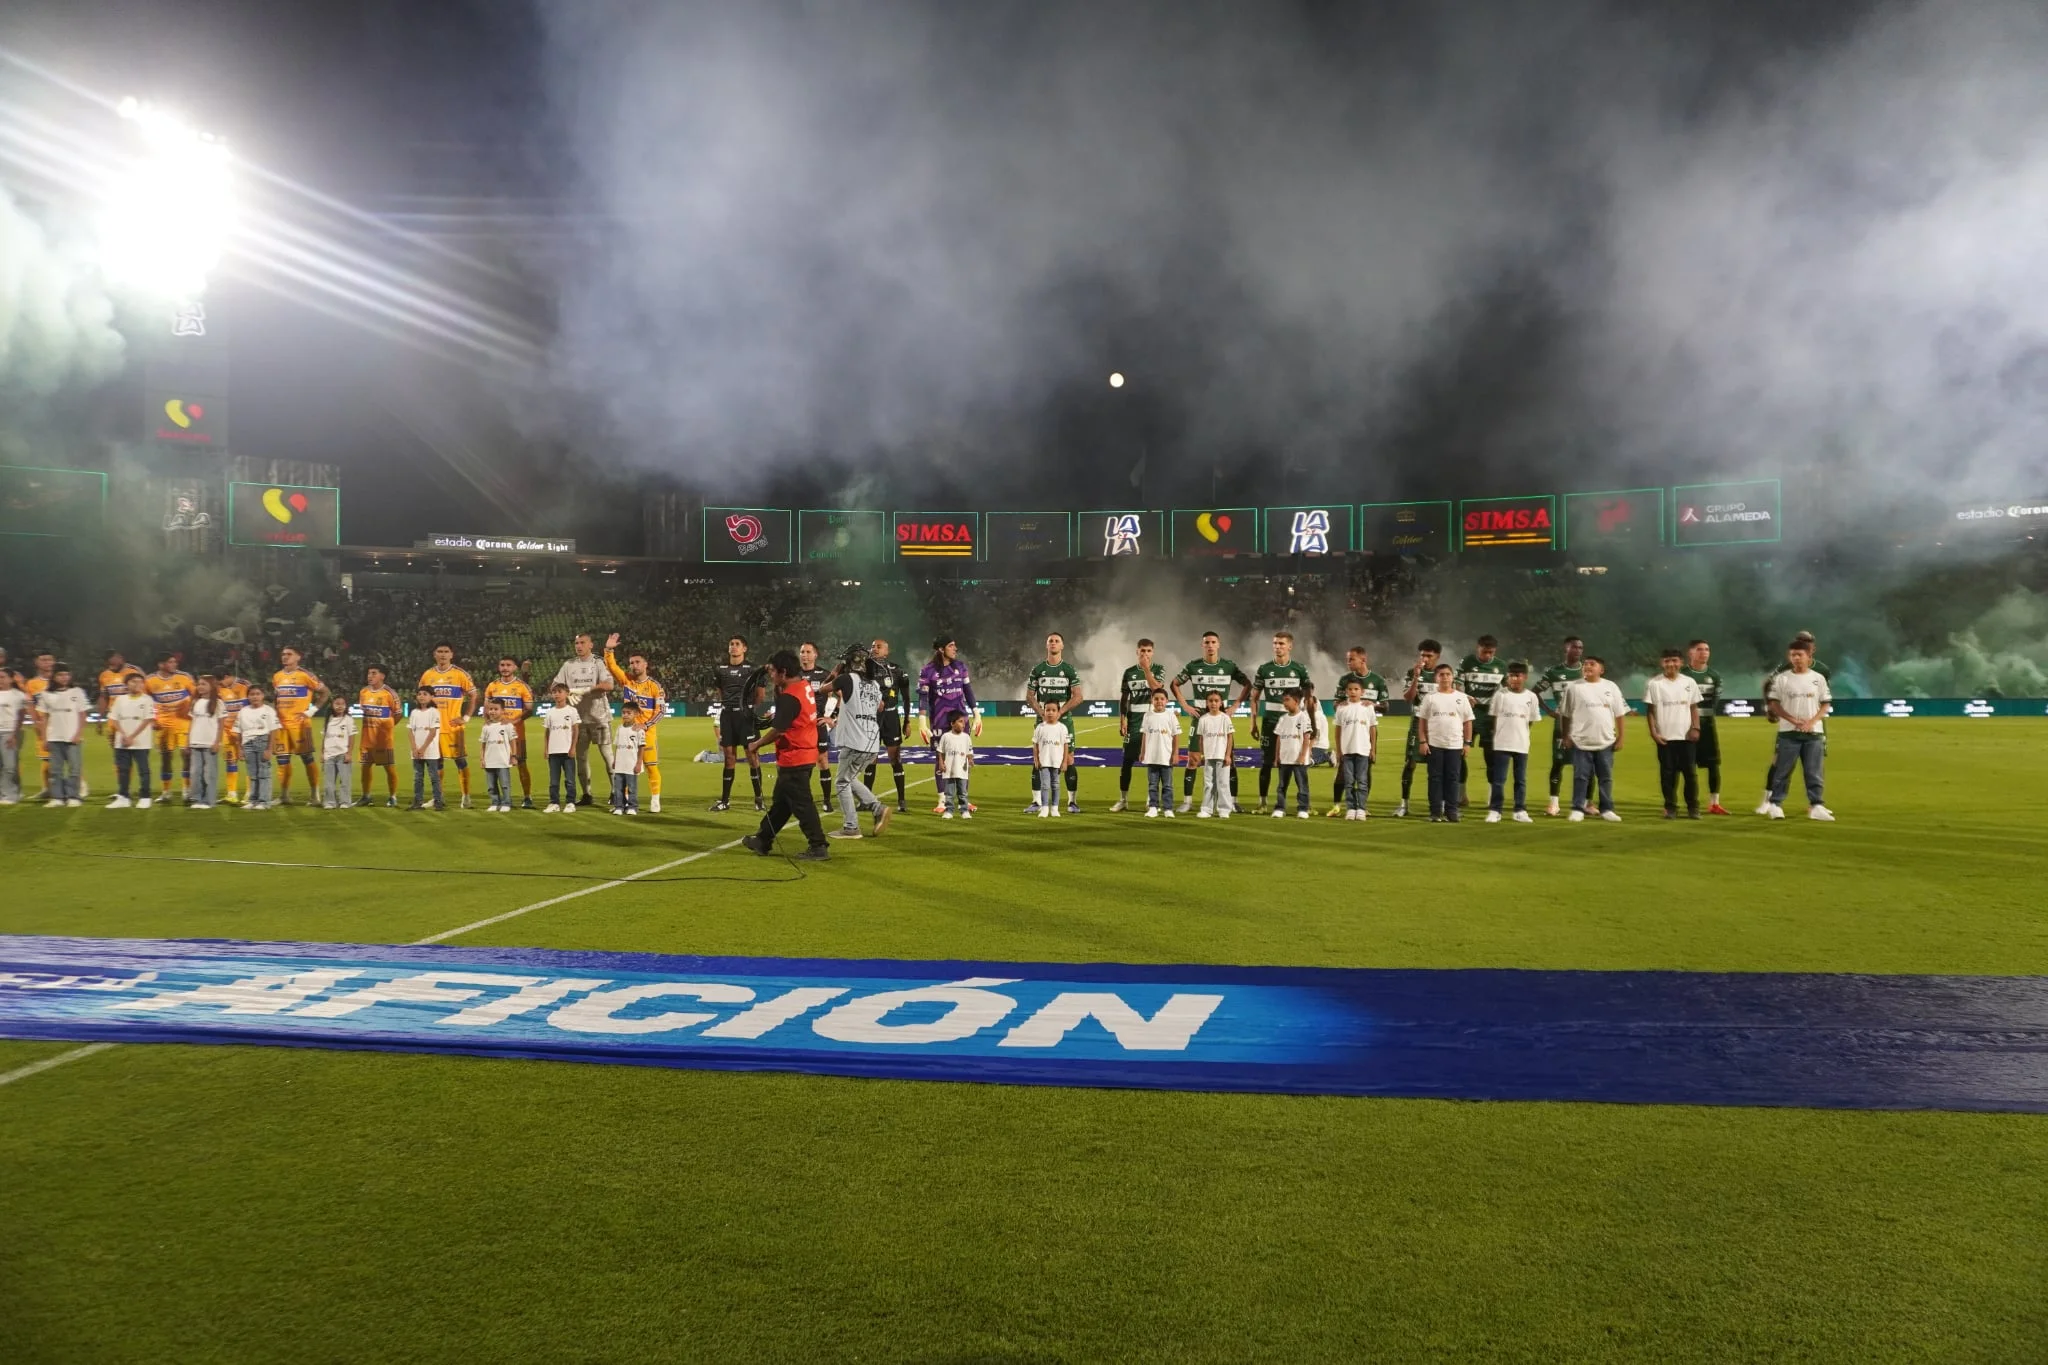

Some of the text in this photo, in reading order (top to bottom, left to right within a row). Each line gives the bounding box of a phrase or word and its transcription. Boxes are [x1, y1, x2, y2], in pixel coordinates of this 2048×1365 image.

[1706, 502, 1746, 513] GRUPO
[1956, 505, 2048, 520] estadio Coron
[1464, 508, 1551, 531] SIMSA
[1705, 511, 1771, 523] ALAMEDA
[896, 523, 972, 542] SIMSA
[435, 536, 473, 547] estadio
[516, 540, 545, 550] Golden
[547, 543, 568, 552] Light
